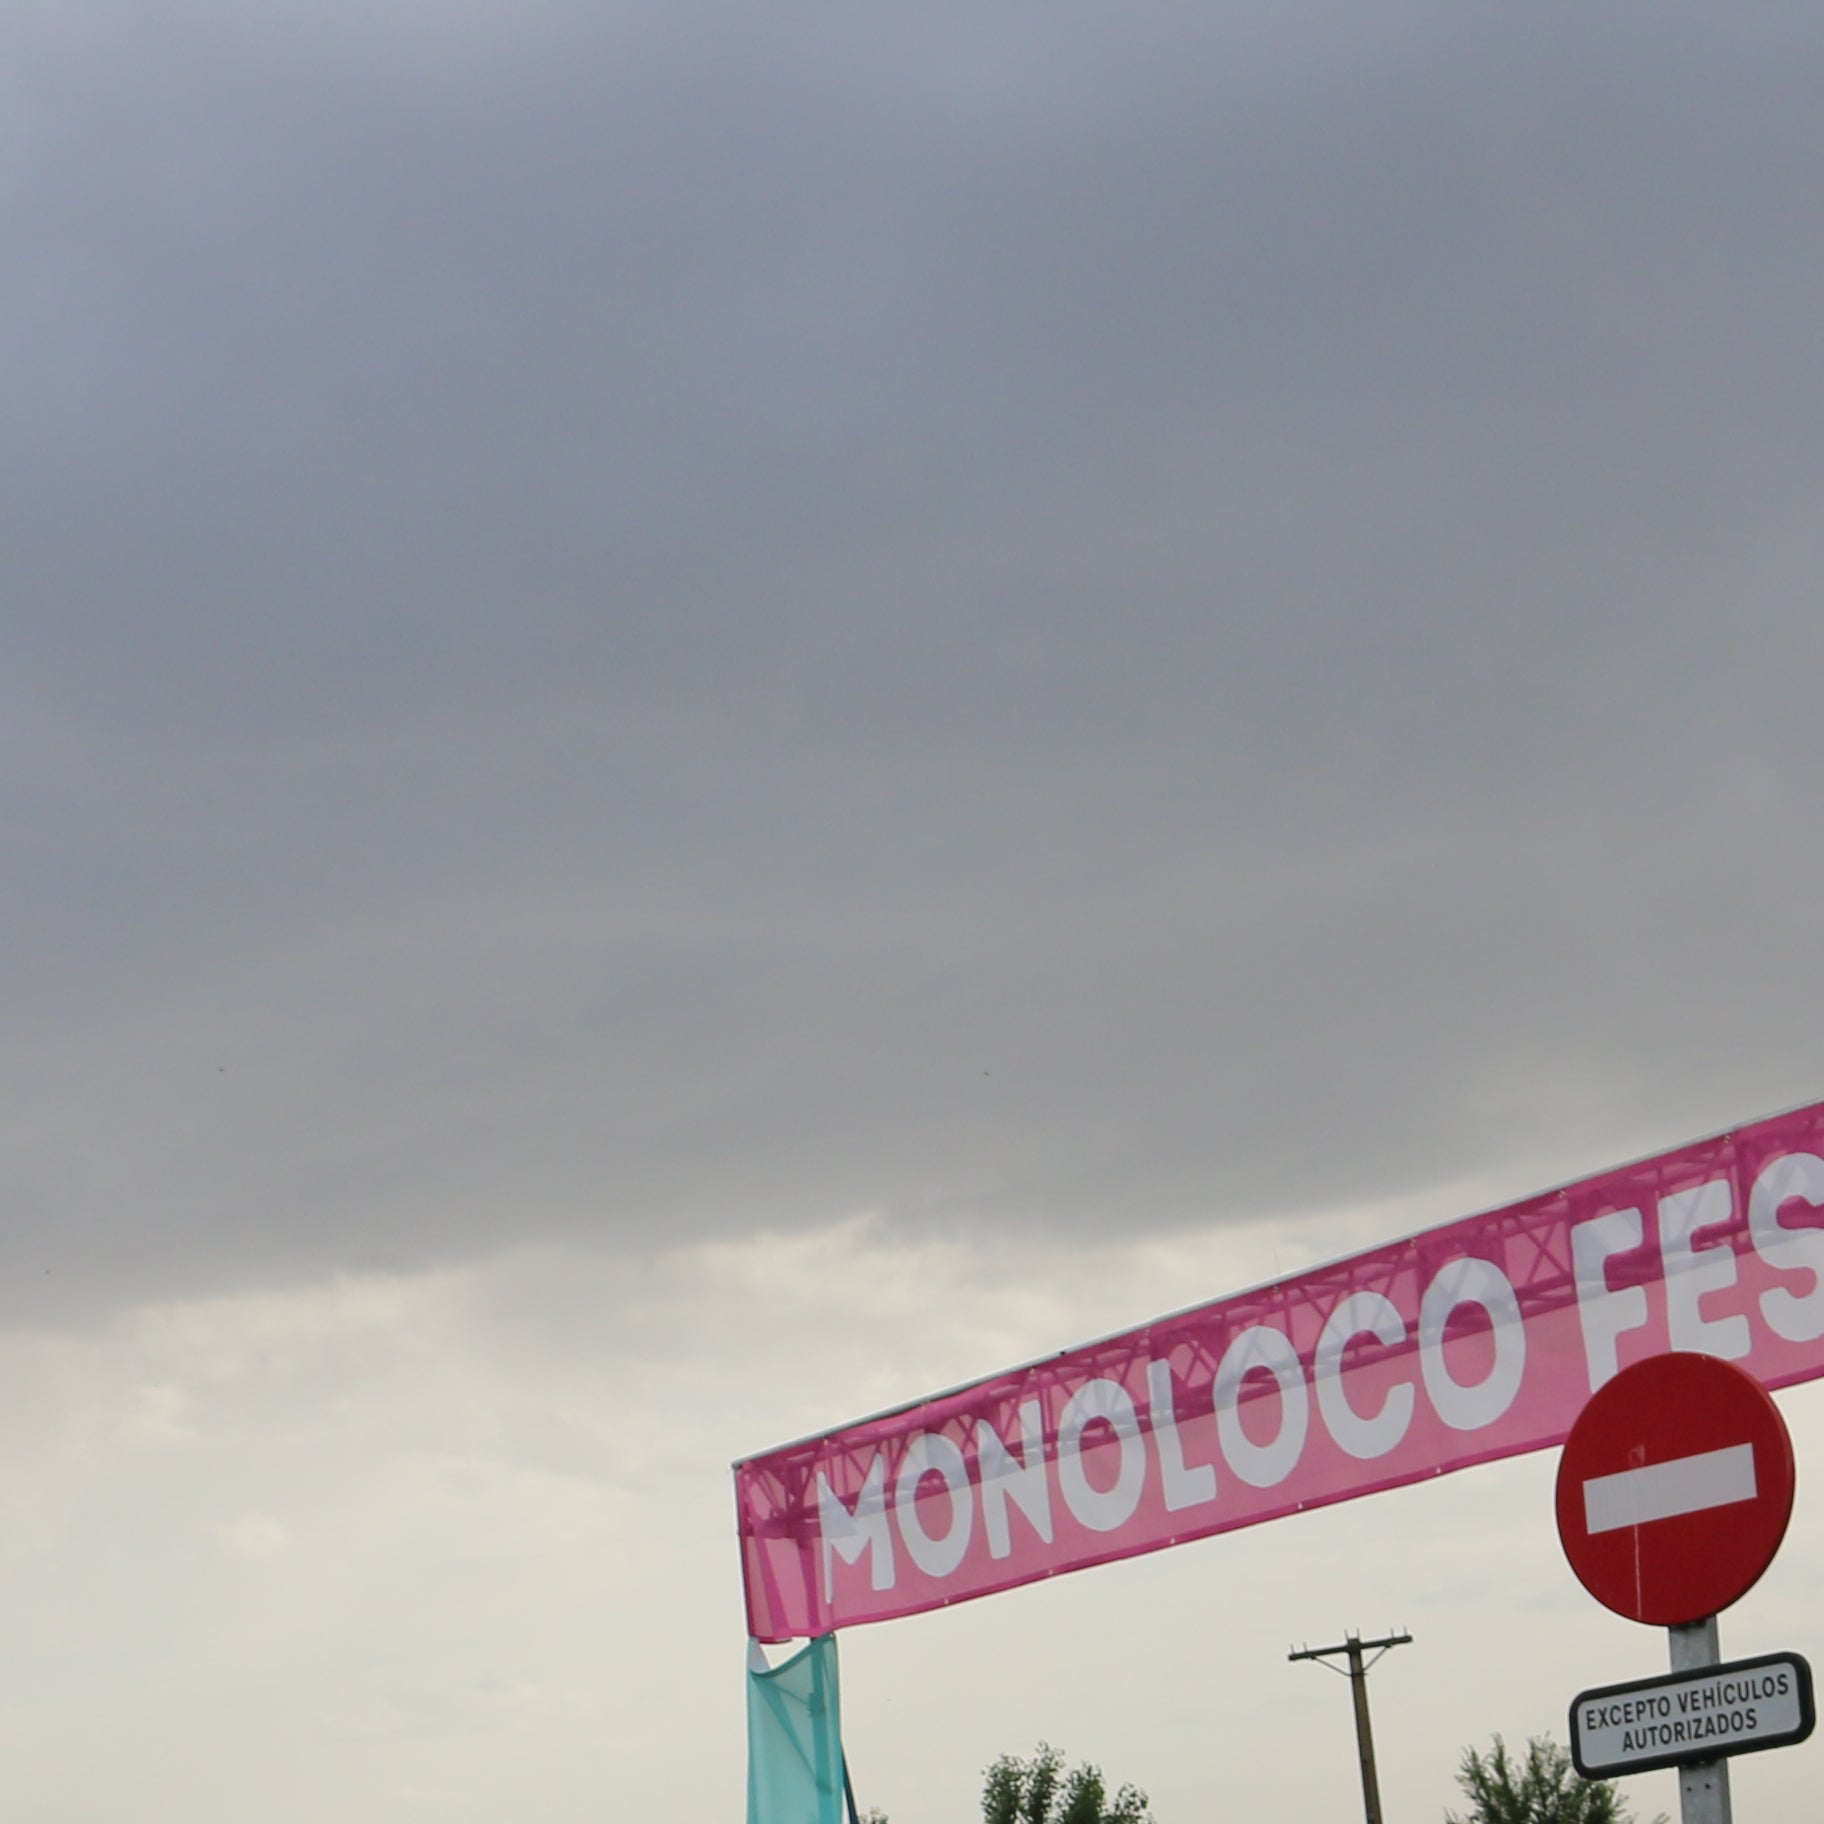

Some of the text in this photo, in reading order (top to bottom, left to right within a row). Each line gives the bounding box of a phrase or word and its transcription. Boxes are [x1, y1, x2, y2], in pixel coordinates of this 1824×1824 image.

[817, 1257, 1526, 1604] MONOLOCO
[1586, 1673, 1789, 1731] EXCEPTO VEHÍCULOS
[1622, 1707, 1758, 1752] AUTORIZADOS
